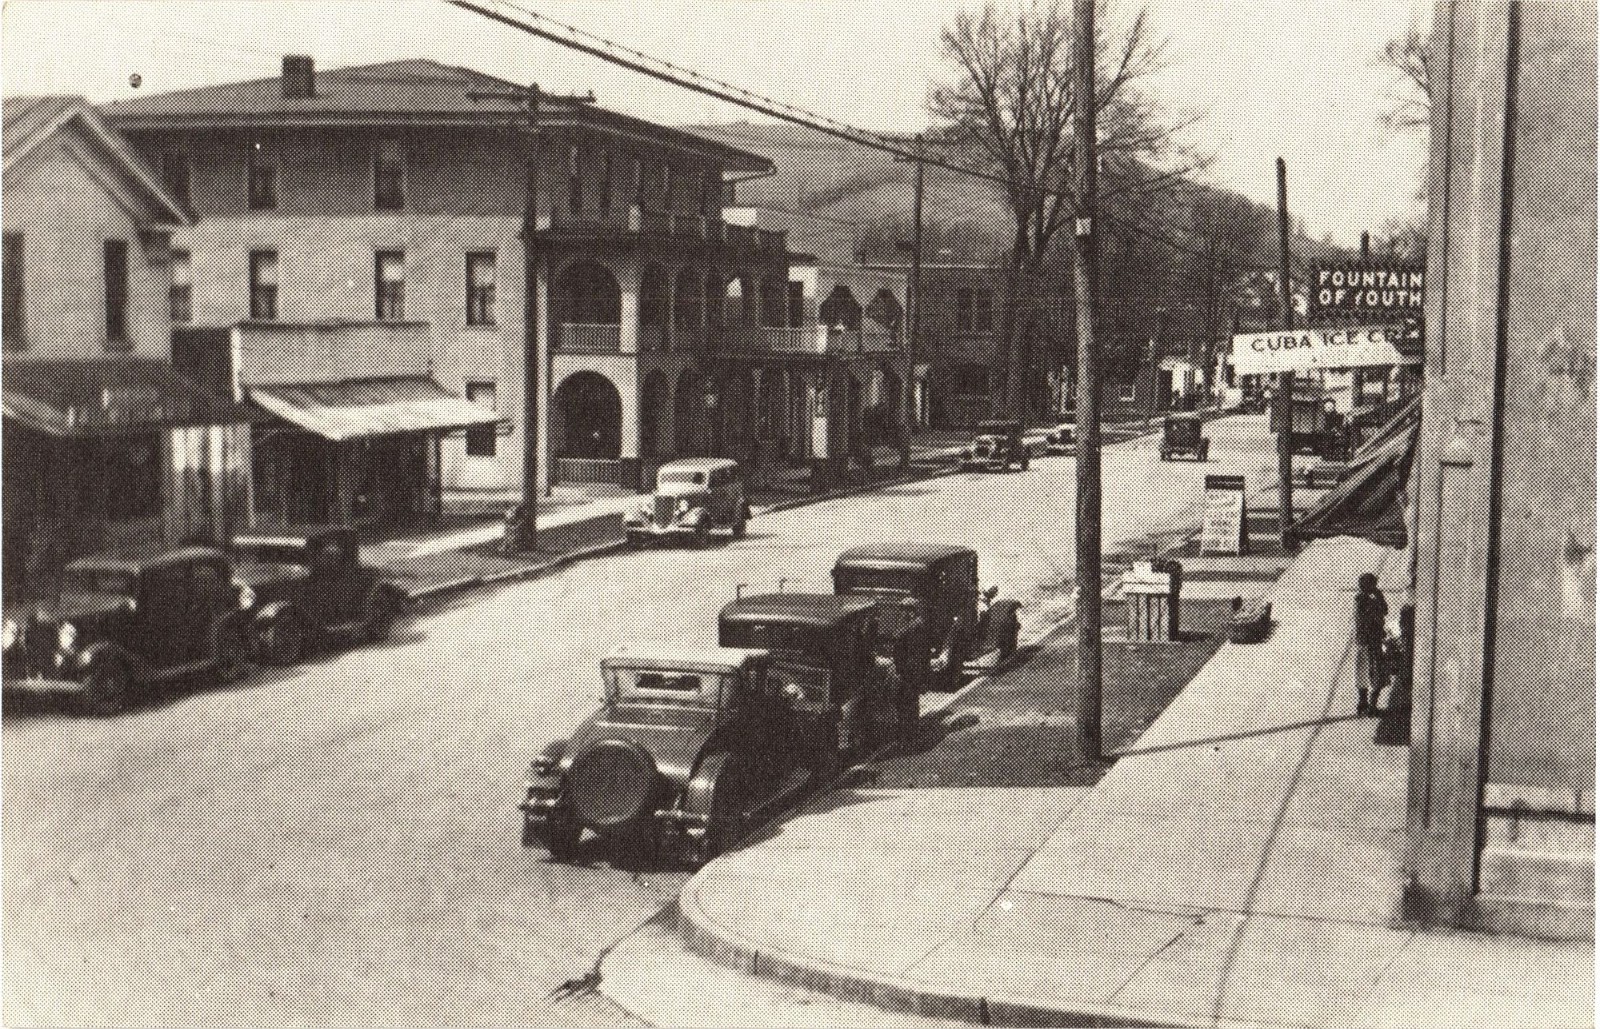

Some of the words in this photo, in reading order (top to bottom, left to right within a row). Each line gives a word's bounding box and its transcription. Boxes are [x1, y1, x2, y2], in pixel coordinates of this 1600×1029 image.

[1319, 270, 1423, 288] FOUNTAIN
[1319, 288, 1347, 305] OF
[1251, 334, 1312, 352] CUBA
[1322, 331, 1359, 347] ICE
